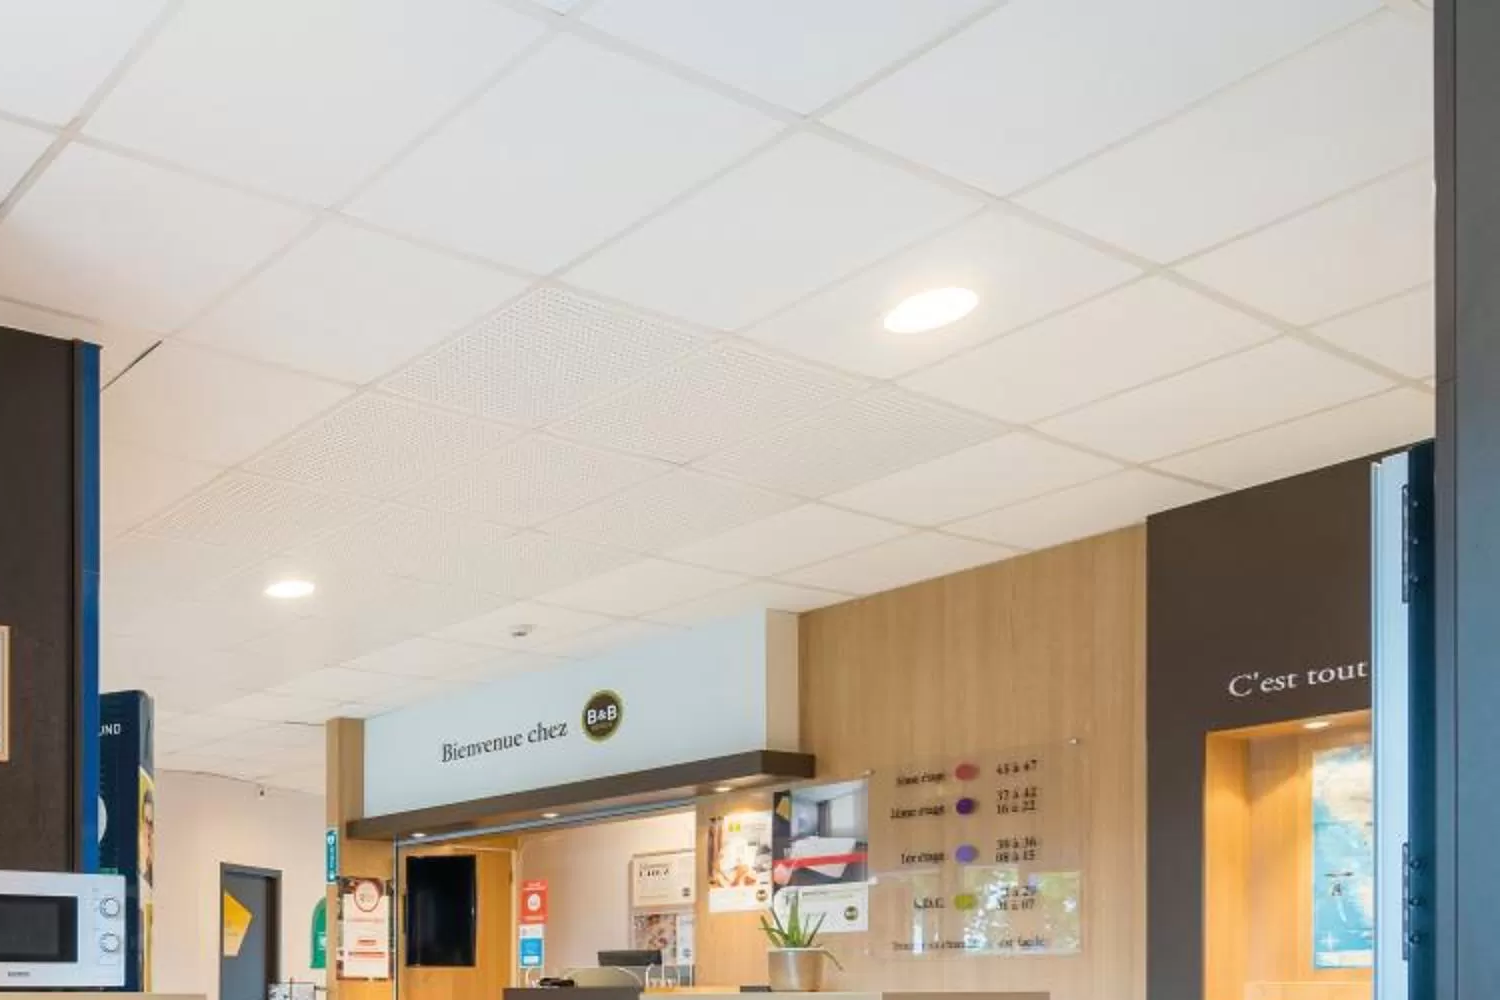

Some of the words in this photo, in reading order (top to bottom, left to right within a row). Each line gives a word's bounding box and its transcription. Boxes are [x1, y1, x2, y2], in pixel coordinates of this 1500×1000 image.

[1228, 671, 1298, 697] C'est
[1307, 661, 1368, 685] tout
[587, 704, 618, 725] B&B
[442, 734, 523, 763] Bienvenue
[527, 721, 568, 744] chez
